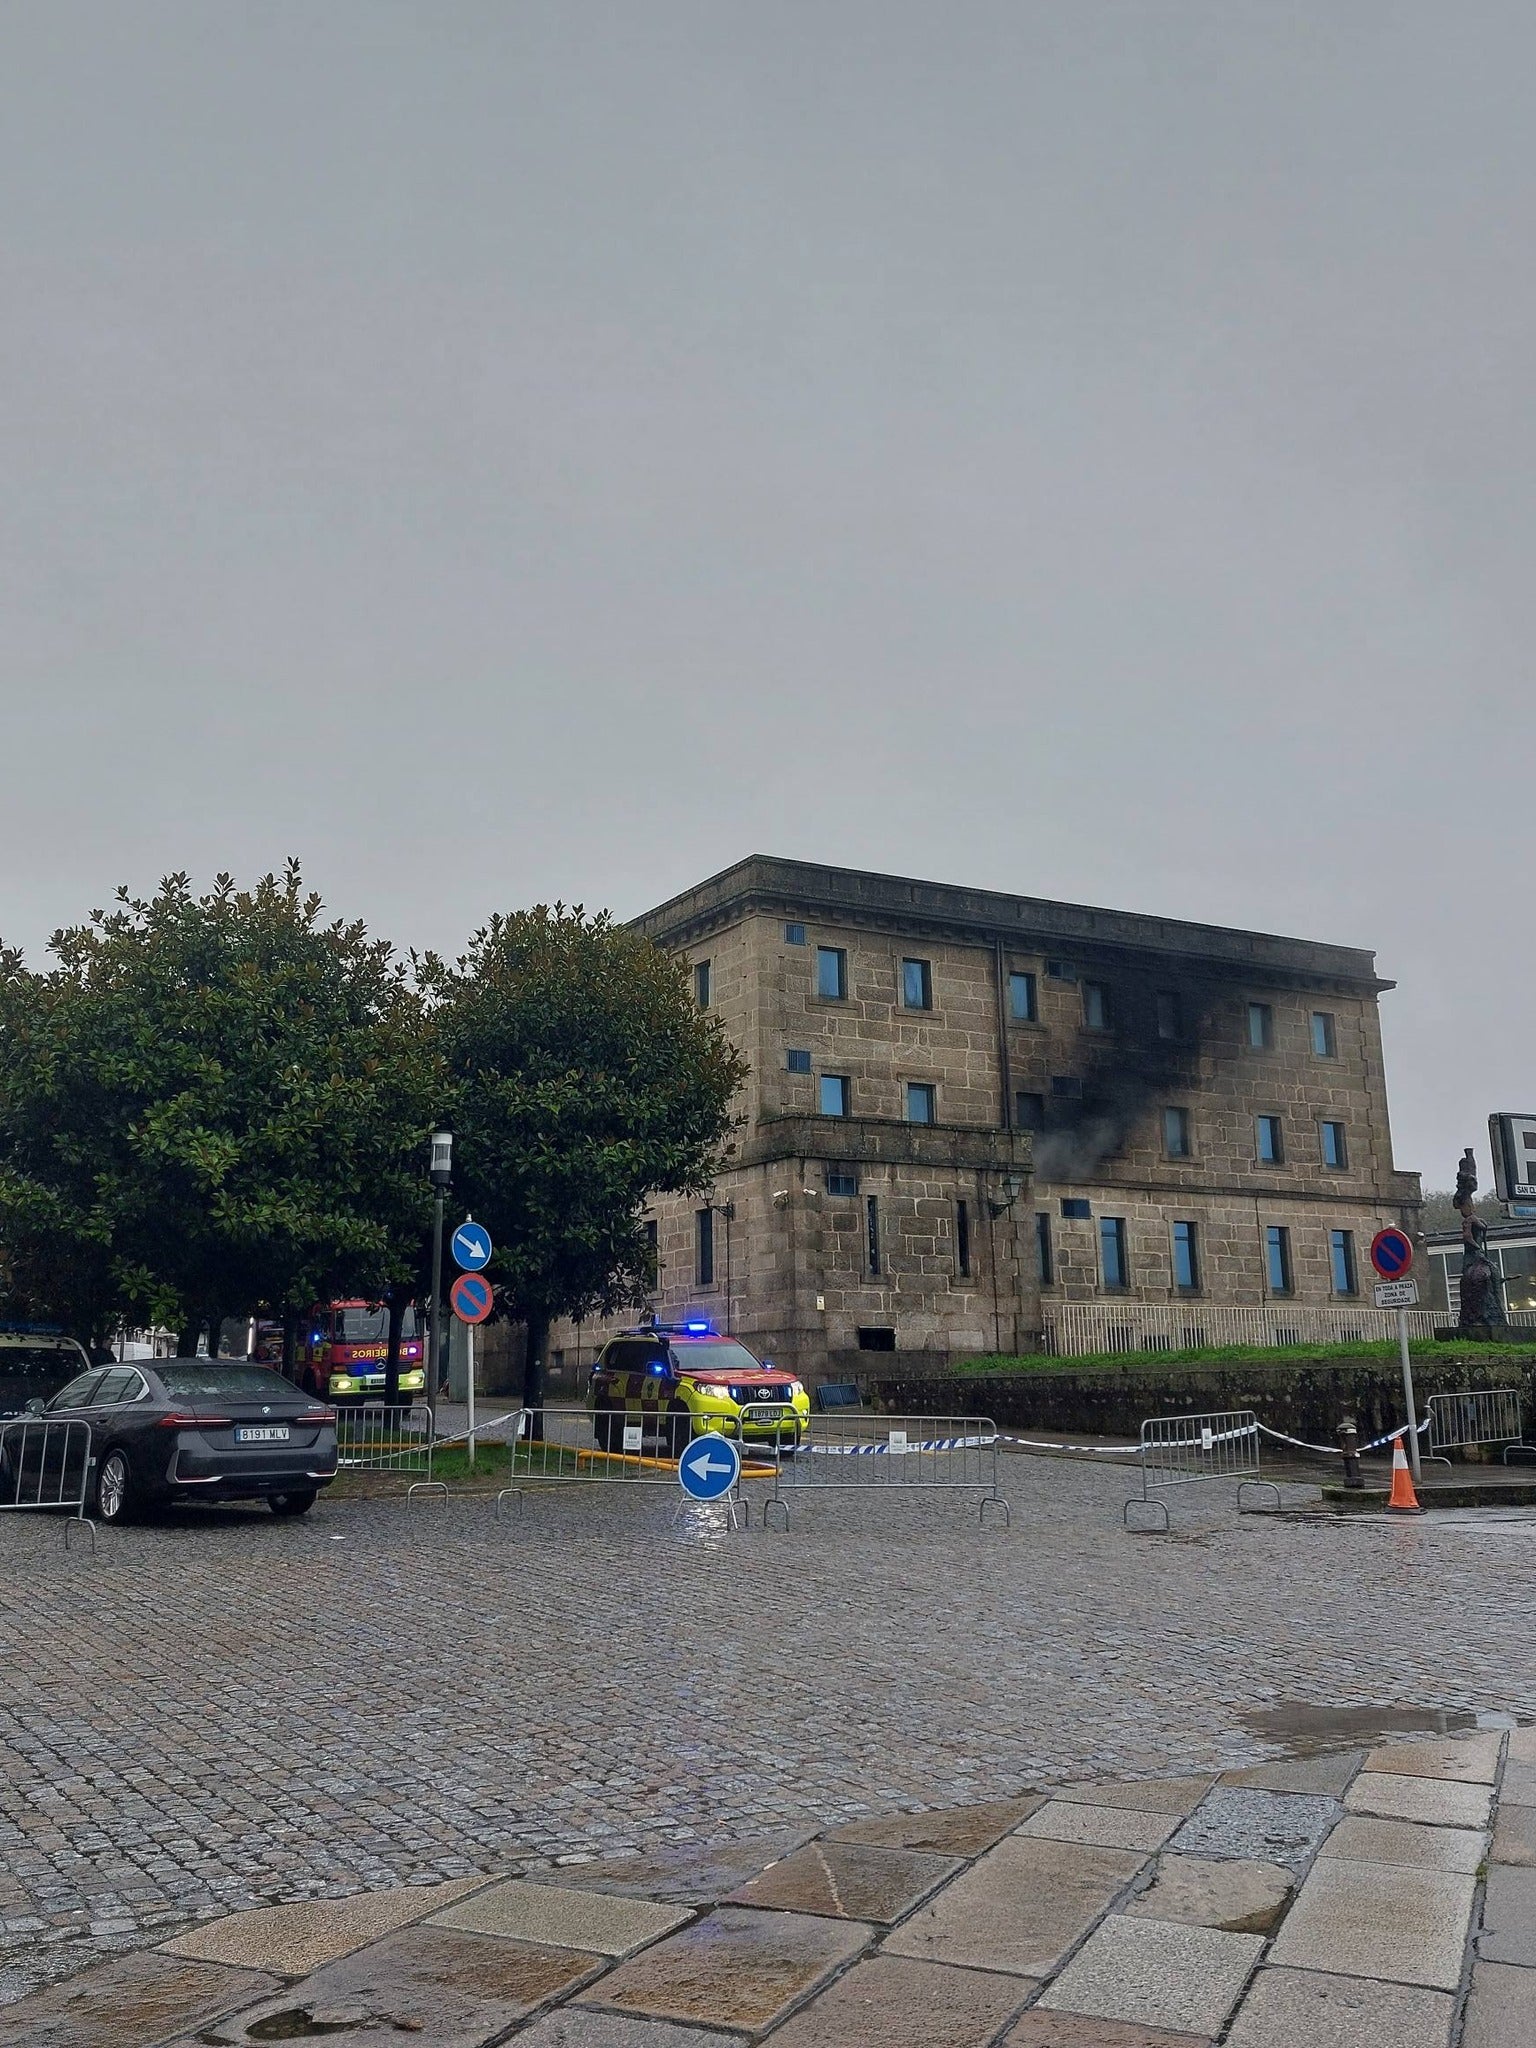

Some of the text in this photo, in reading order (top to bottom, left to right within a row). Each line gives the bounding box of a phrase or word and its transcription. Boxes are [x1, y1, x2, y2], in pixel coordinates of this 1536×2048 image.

[1517, 1186, 1528, 1194] SAN
[1381, 1297, 1411, 1305] SEGURIDADE
[242, 1429, 287, 1439] 8191 MLV
